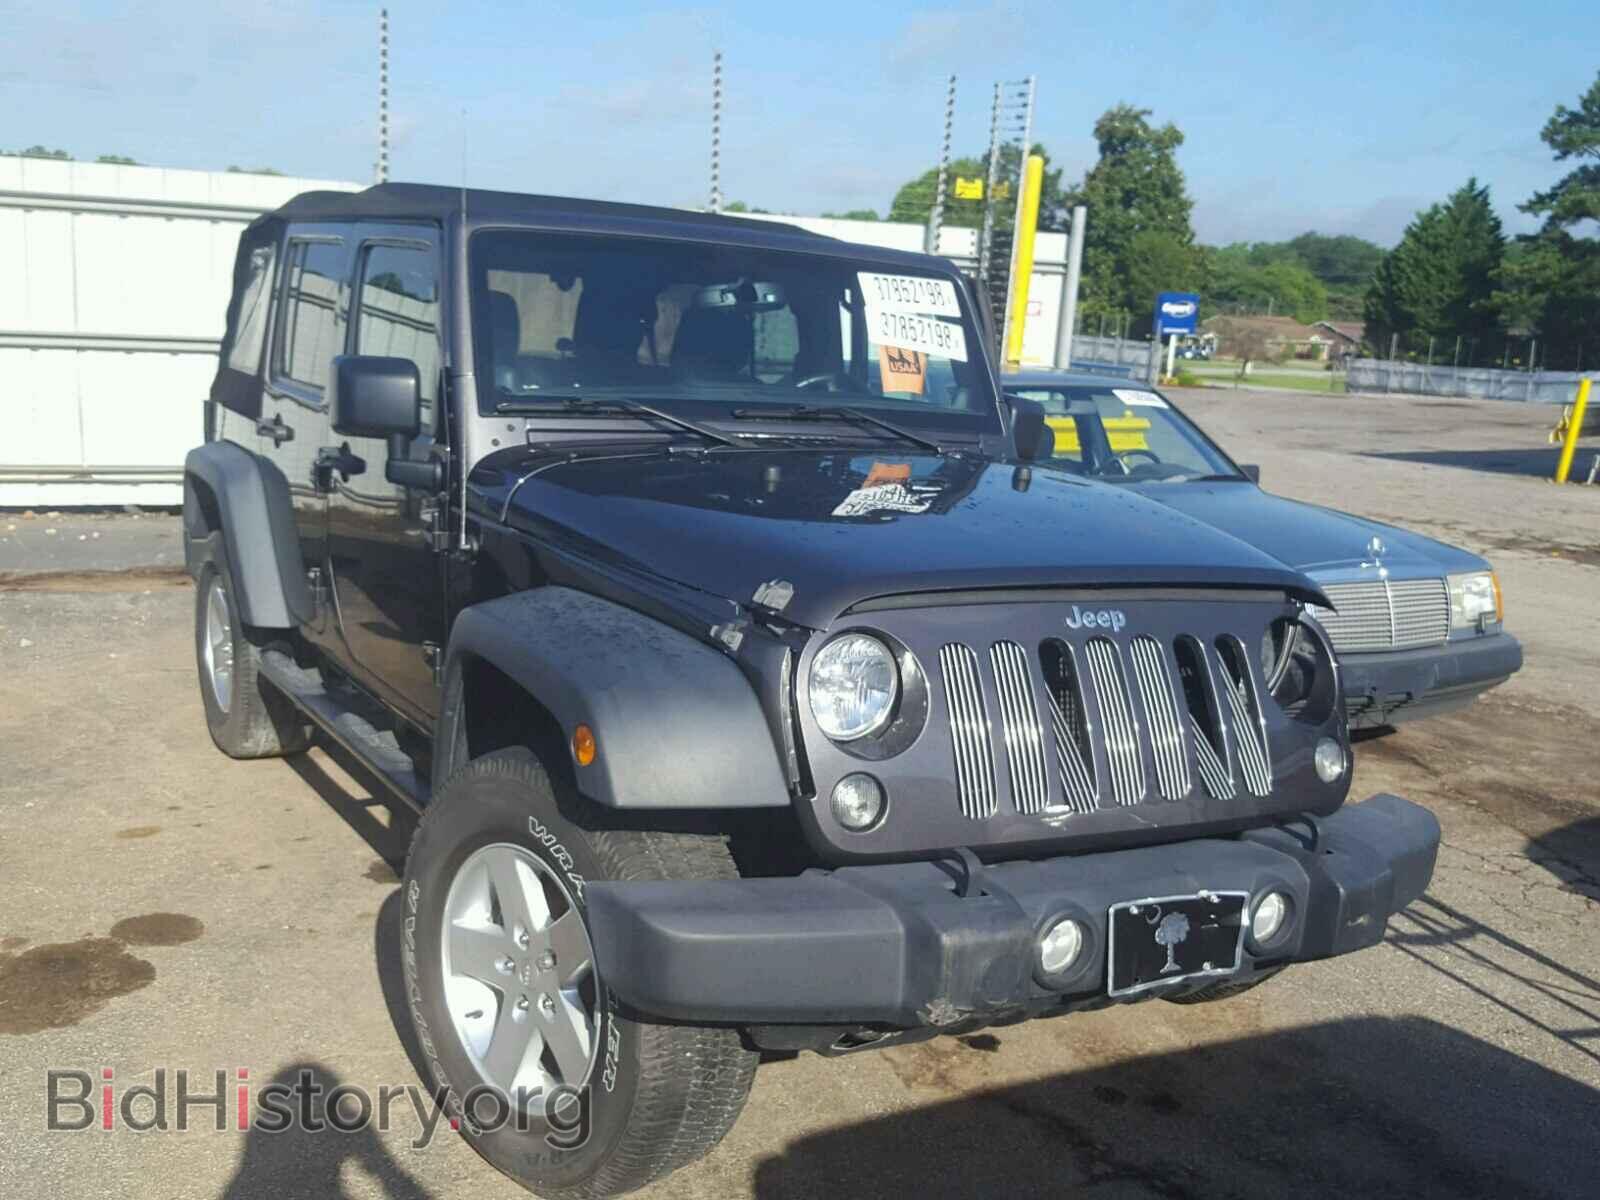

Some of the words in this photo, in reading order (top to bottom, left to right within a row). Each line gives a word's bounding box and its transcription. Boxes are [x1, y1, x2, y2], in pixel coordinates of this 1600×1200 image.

[873, 276, 945, 306] 37852198
[880, 312, 951, 349] 37852198
[1065, 605, 1126, 632] Jeep
